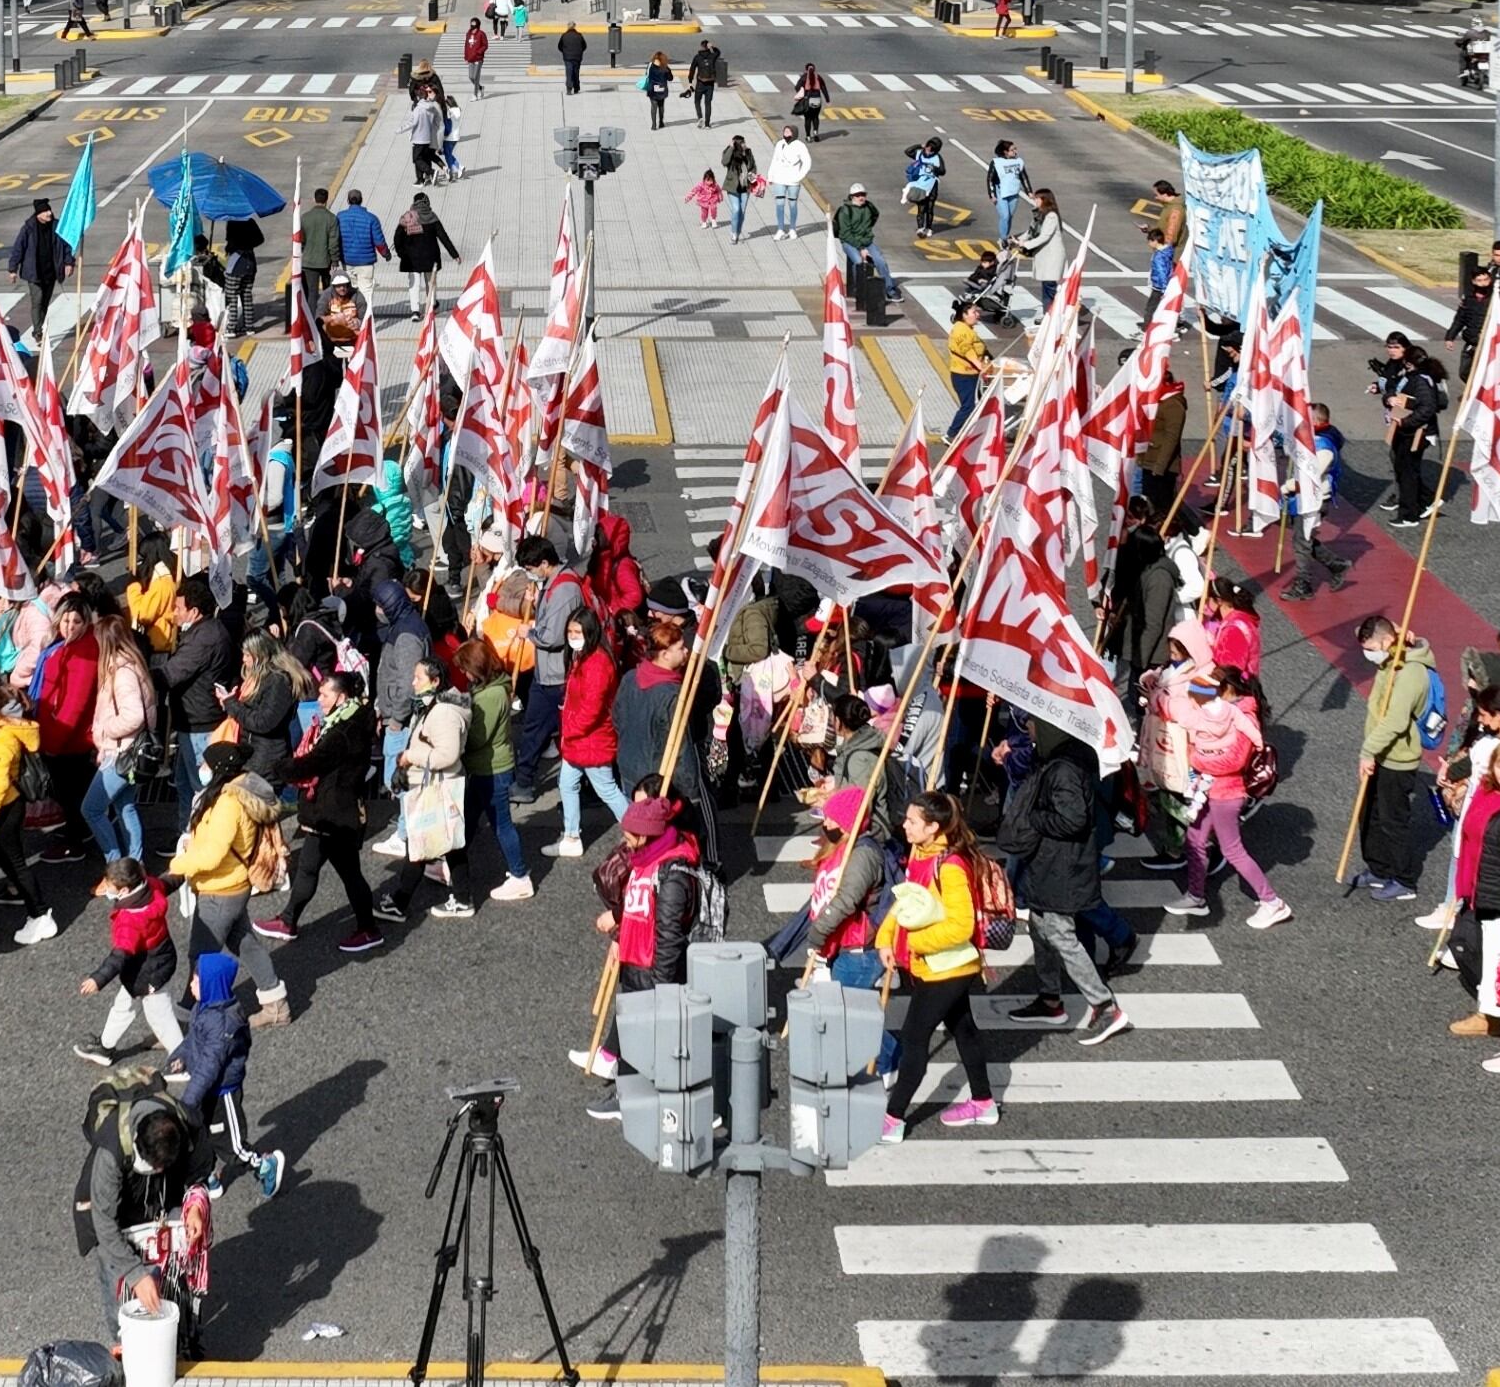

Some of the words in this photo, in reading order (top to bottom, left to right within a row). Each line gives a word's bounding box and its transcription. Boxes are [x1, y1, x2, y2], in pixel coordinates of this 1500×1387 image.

[73, 107, 167, 122] BUS
[242, 107, 332, 122] BUS
[961, 108, 1057, 122] BUS
[989, 668, 1032, 700] Socialista
[1031, 691, 1046, 709] de
